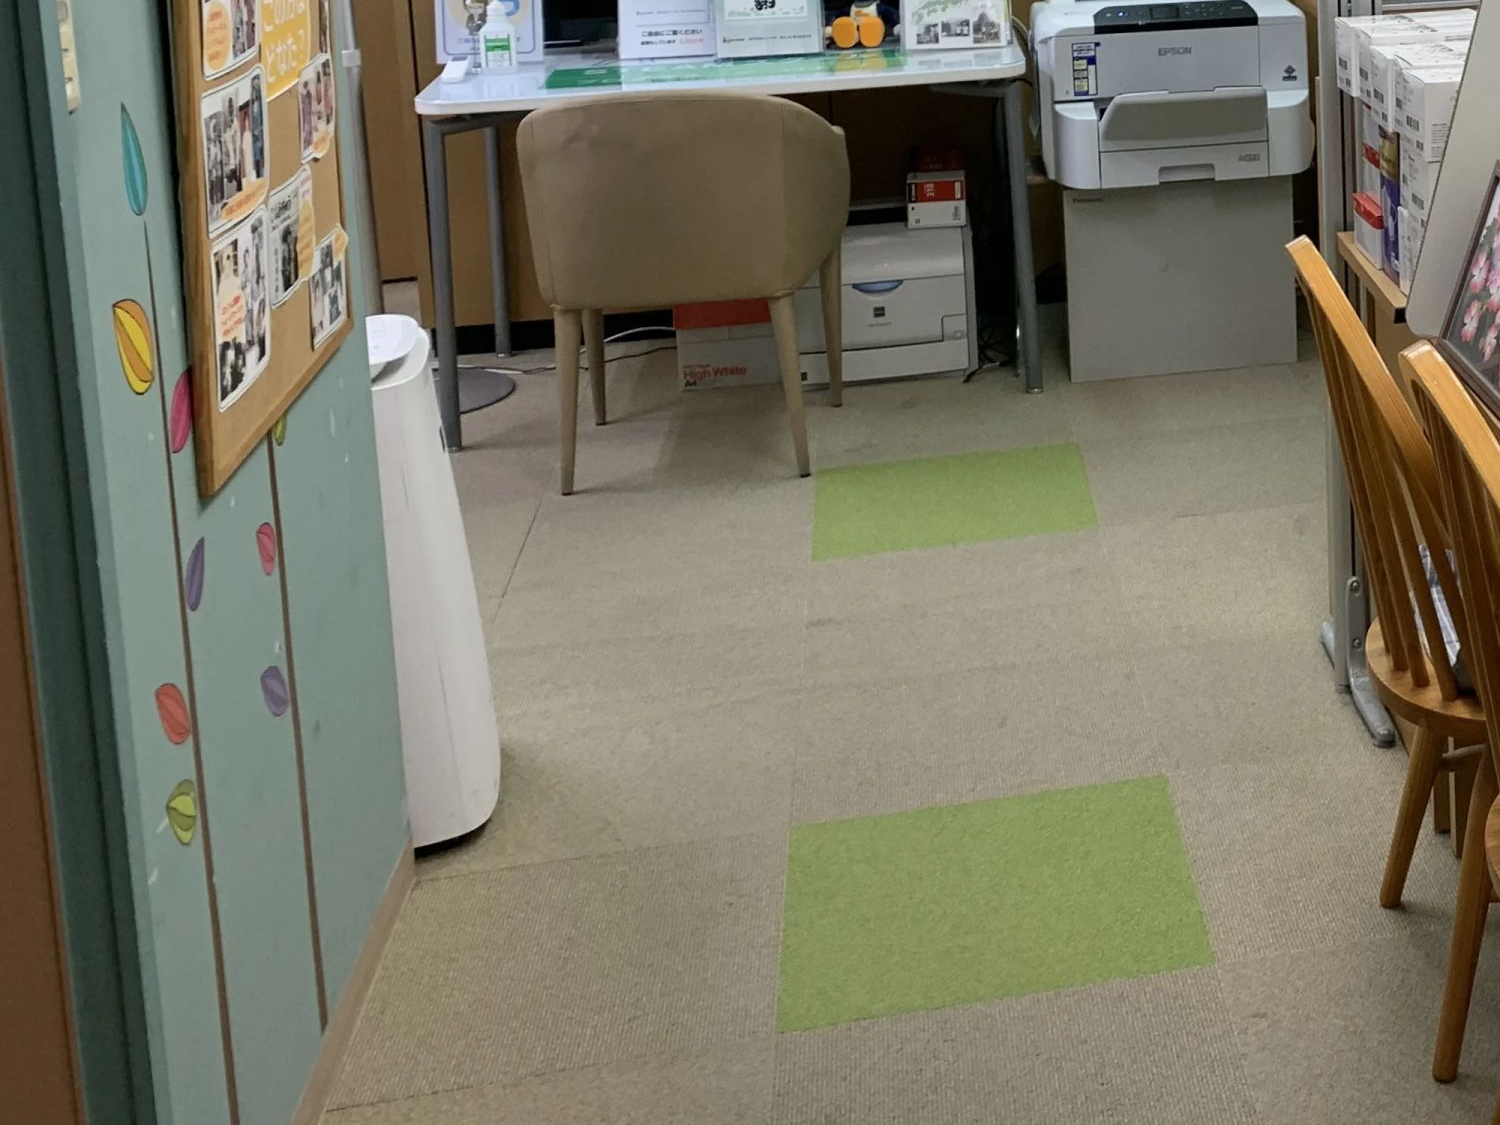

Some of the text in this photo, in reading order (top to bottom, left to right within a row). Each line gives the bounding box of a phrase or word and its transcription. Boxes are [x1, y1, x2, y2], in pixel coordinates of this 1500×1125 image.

[1158, 46, 1192, 56] EPSON
[684, 368, 712, 380] High
[712, 366, 747, 376] White
[685, 379, 697, 387] A4
